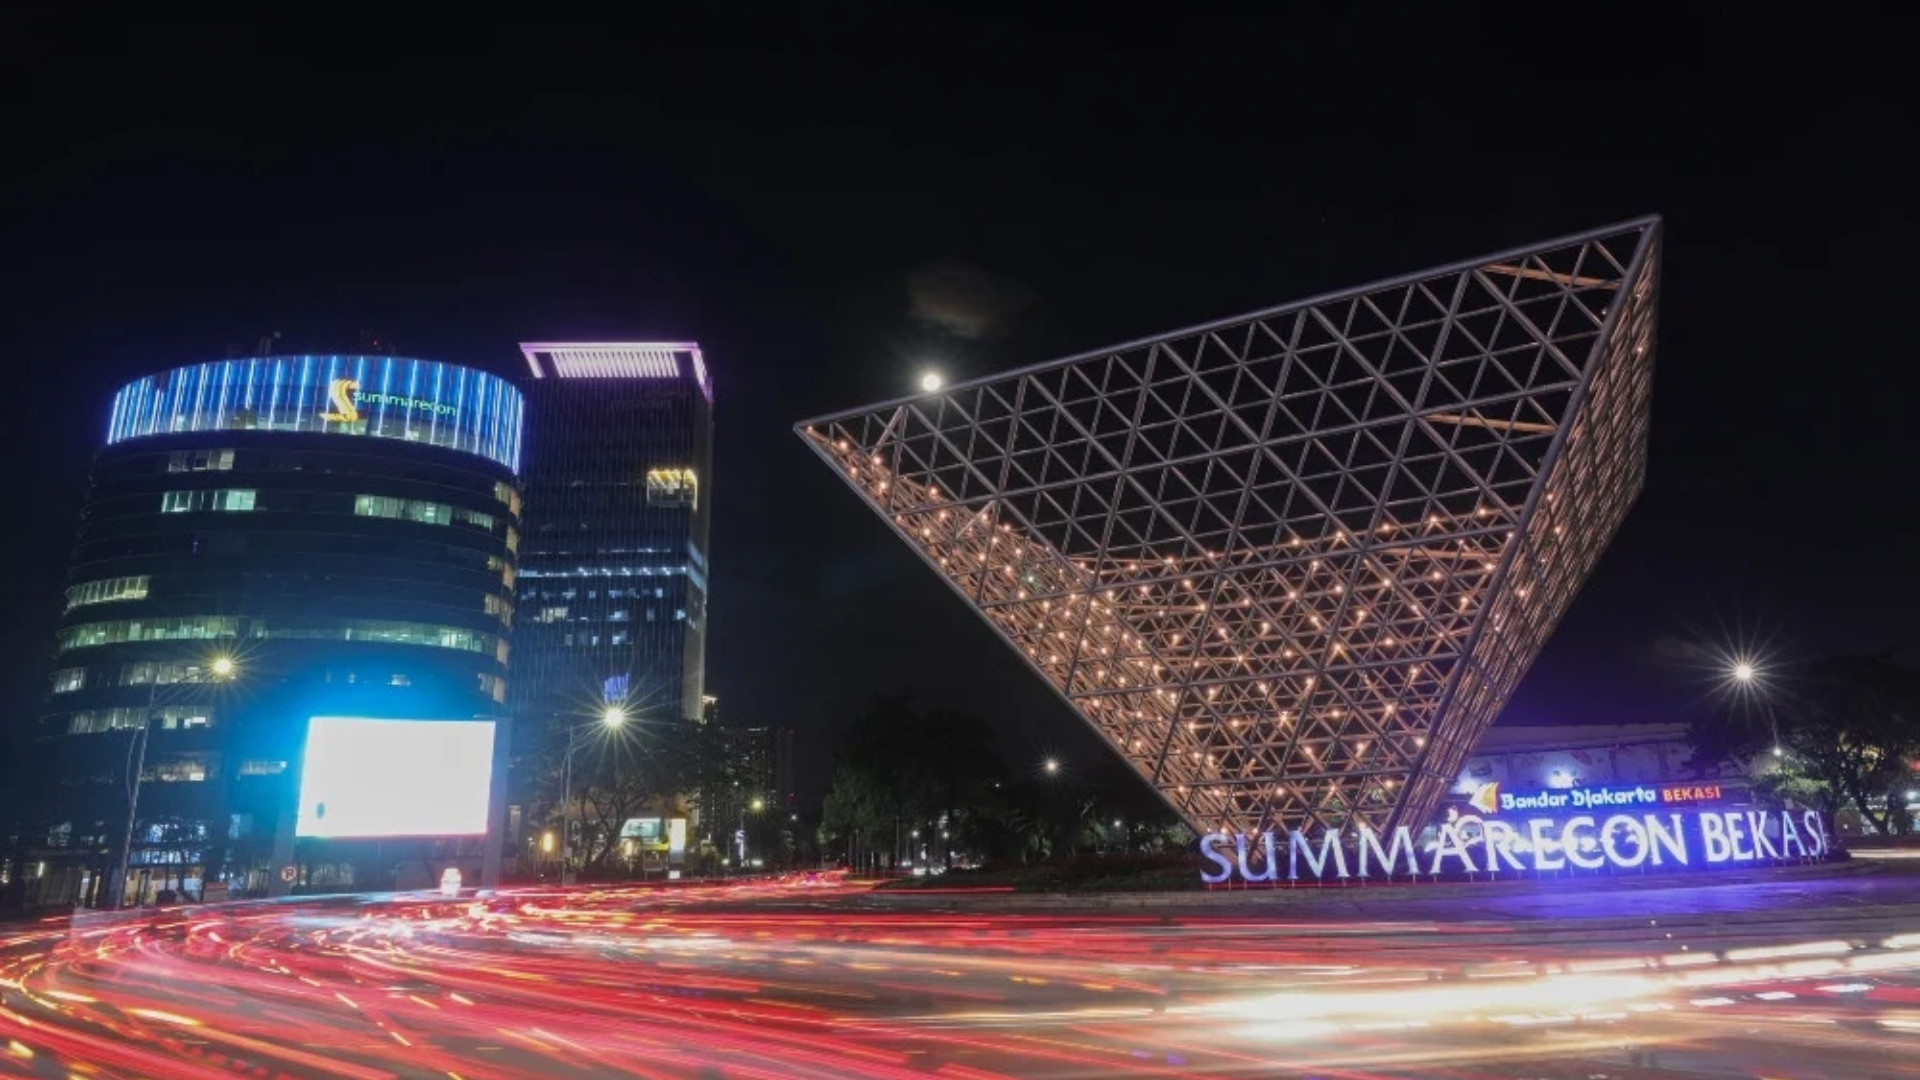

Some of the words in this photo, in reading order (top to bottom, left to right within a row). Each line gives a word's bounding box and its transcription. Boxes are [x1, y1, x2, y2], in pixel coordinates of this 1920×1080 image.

[353, 392, 456, 416] summarecon
[1501, 791, 1568, 809] Bandar
[1571, 786, 1656, 808] Djakarta
[1662, 786, 1720, 802] BEKASI
[1200, 814, 1689, 883] SUMMARECON
[1699, 811, 1829, 862] BEKASI
